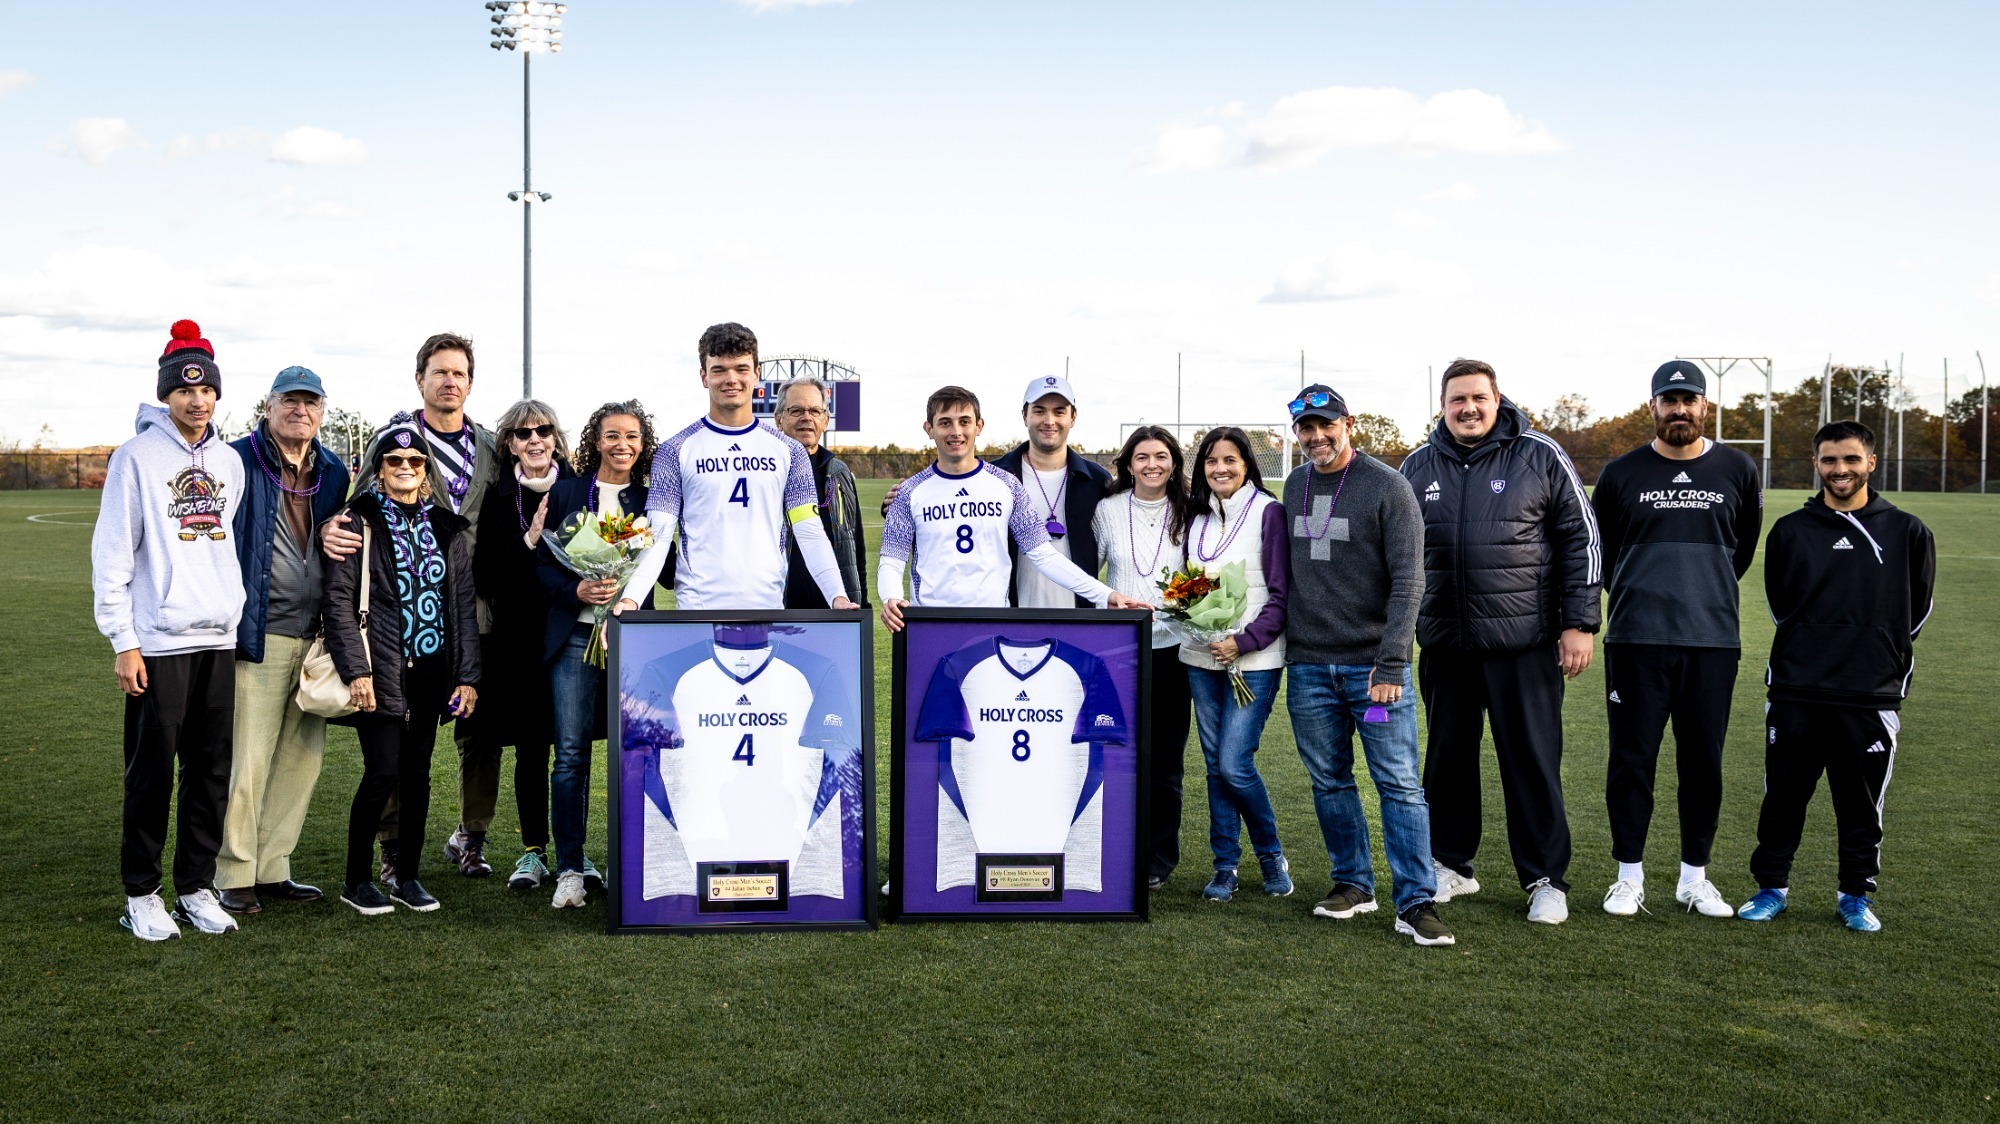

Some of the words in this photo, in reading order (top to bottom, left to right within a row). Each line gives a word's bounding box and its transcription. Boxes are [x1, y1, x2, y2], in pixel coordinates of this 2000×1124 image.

[696, 457, 729, 474] HOLY
[733, 457, 777, 472] CROSS
[728, 477, 750, 508] 4
[1425, 492, 1440, 502] MB
[1639, 489, 1677, 503] HOLY
[1678, 489, 1725, 504] CROSS
[922, 503, 956, 523] HOLY
[960, 501, 1003, 518] CROSS
[1653, 501, 1710, 509] CRUSADERS
[956, 524, 974, 554] 8
[698, 713, 736, 727] HOLY
[738, 712, 788, 727] CROSS
[980, 708, 1016, 723] HOLY
[1017, 708, 1063, 723] CROSS
[731, 733, 756, 767] 4
[1011, 729, 1031, 762] 8
[990, 869, 1002, 877] Holy
